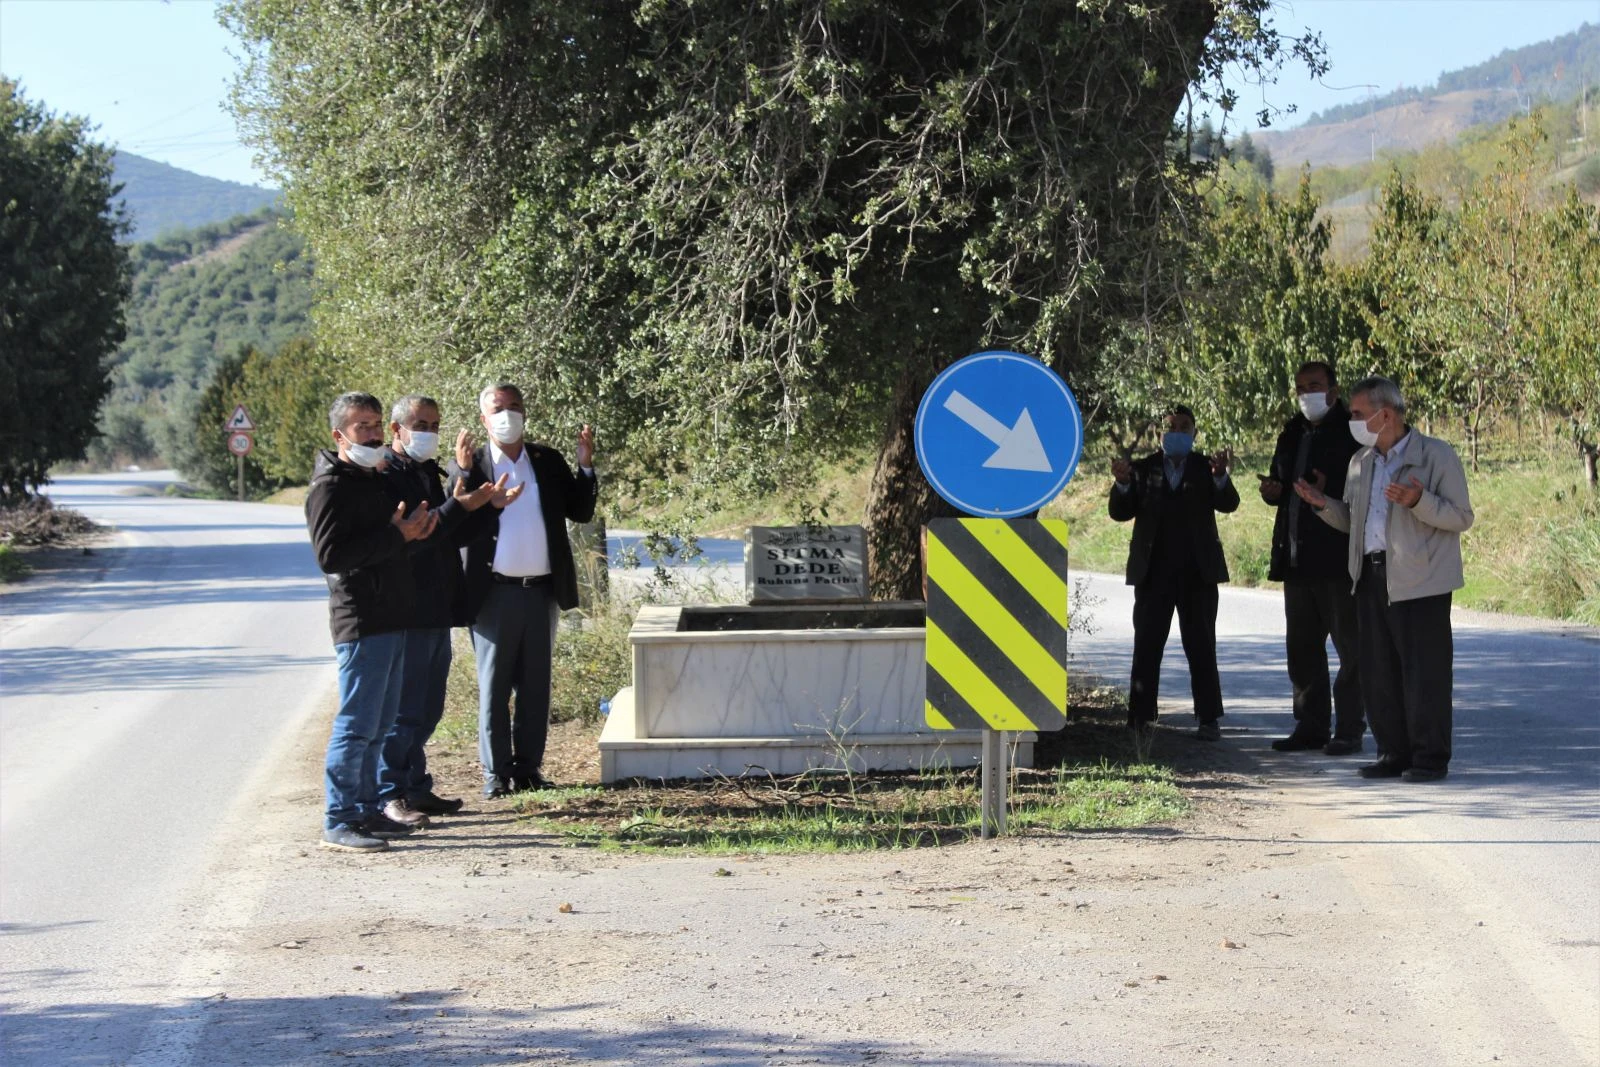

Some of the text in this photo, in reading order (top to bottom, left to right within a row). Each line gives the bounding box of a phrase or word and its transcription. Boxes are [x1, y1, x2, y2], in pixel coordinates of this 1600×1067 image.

[234, 438, 247, 449] 30
[775, 563, 841, 576] DEDE
[757, 576, 809, 585] Ruhuna
